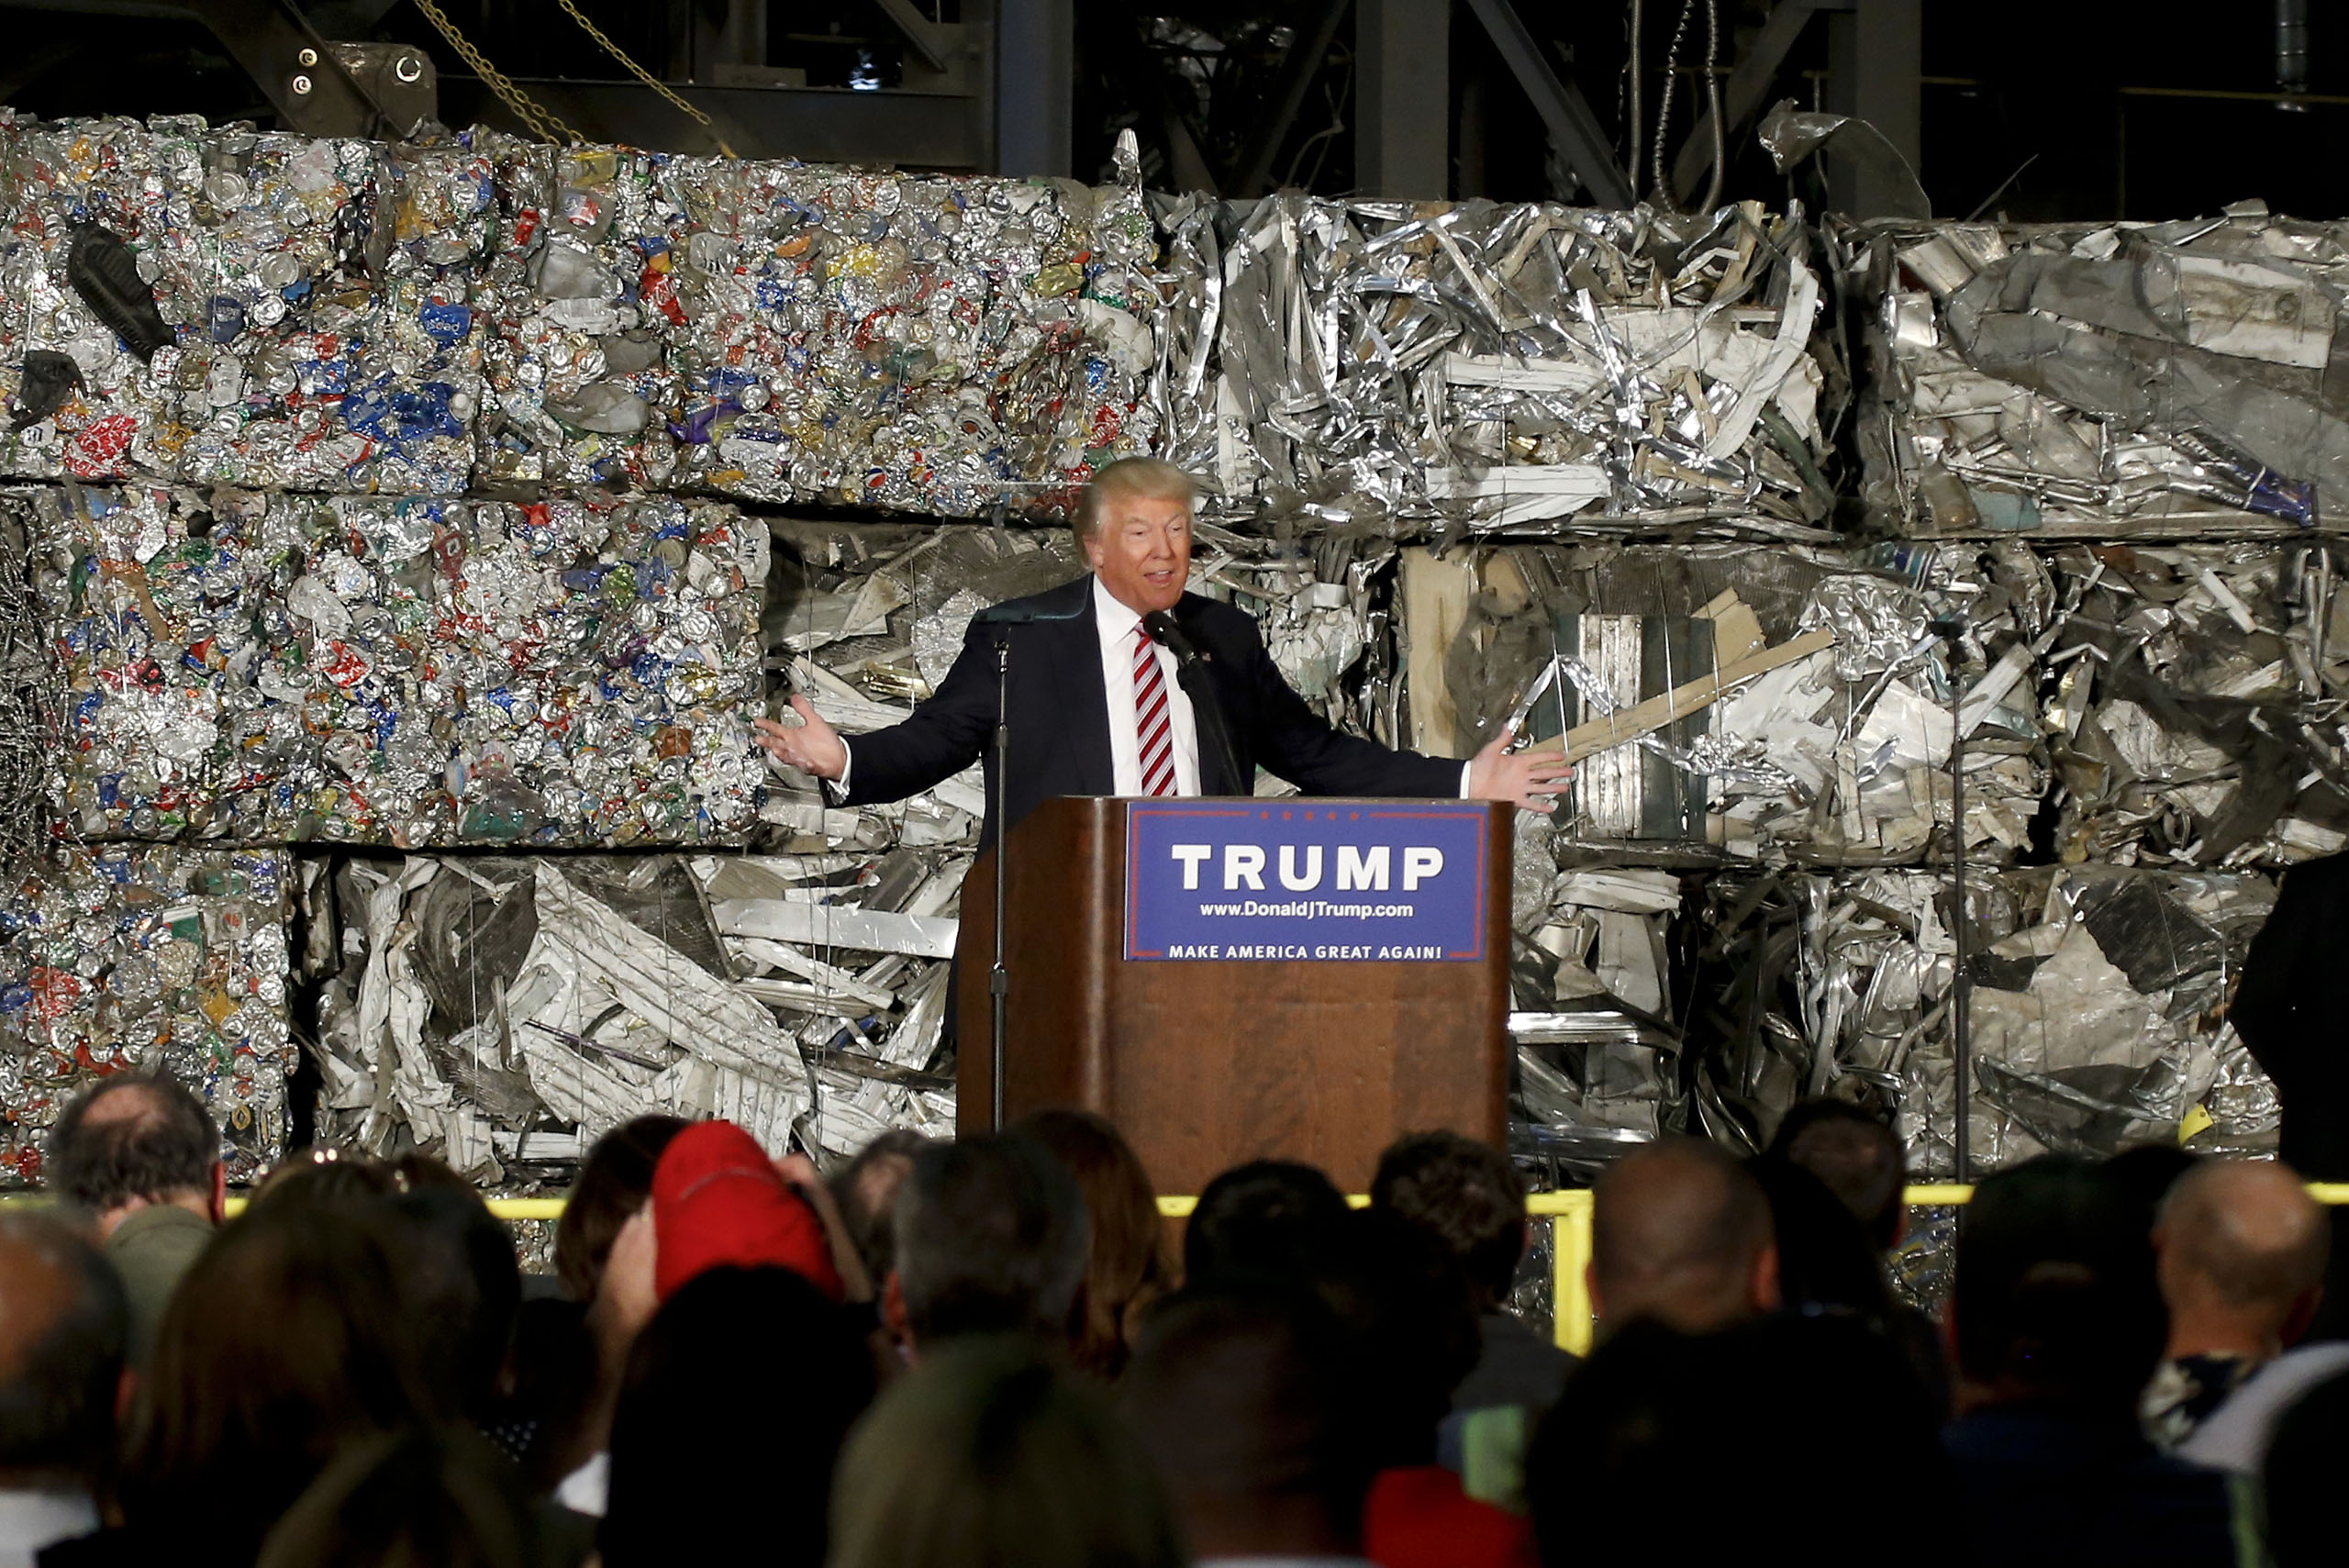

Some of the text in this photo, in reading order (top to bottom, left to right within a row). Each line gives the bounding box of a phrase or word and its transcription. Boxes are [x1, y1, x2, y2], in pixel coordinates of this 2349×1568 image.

[1171, 844, 1443, 892] TRUMP
[1200, 901, 1414, 919] www.DonaldJTrump.com
[1169, 945, 1442, 960] MAKE AMERICA GREAT AGAIN!
